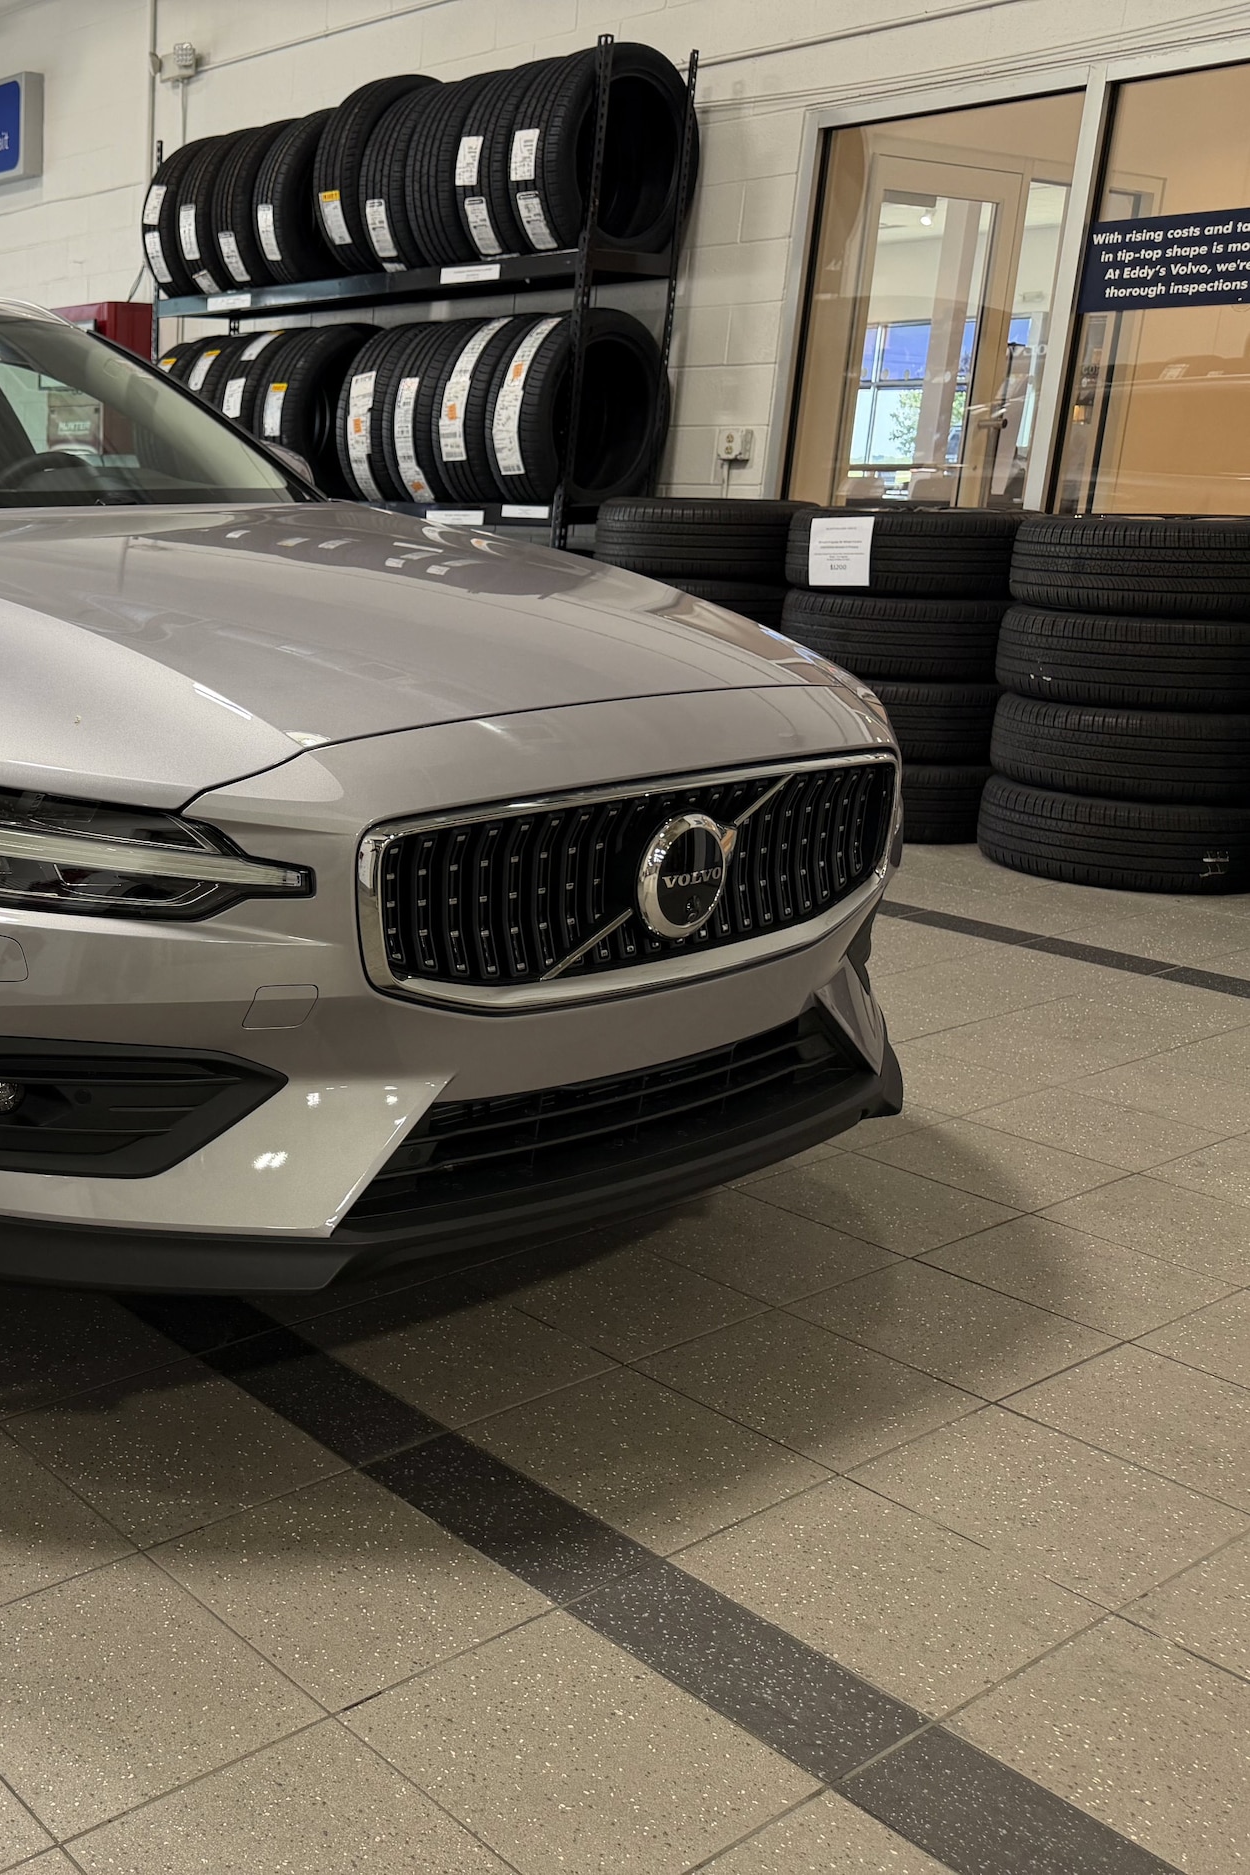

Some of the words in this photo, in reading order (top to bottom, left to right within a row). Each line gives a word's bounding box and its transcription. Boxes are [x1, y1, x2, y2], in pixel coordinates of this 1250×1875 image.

[1092, 231, 1122, 246] With
[1125, 228, 1164, 244] rising
[1167, 225, 1201, 239] costs
[1204, 220, 1233, 235] and
[1100, 250, 1114, 263] in
[1116, 247, 1162, 264] tip-top
[1165, 244, 1208, 259] shape
[1211, 241, 1224, 254] is
[1104, 266, 1120, 280] At
[1170, 260, 1213, 276] Volvo,
[1104, 282, 1166, 299] thorough
[1169, 278, 1249, 296] inspections
[662, 866, 722, 889] VOLVO
